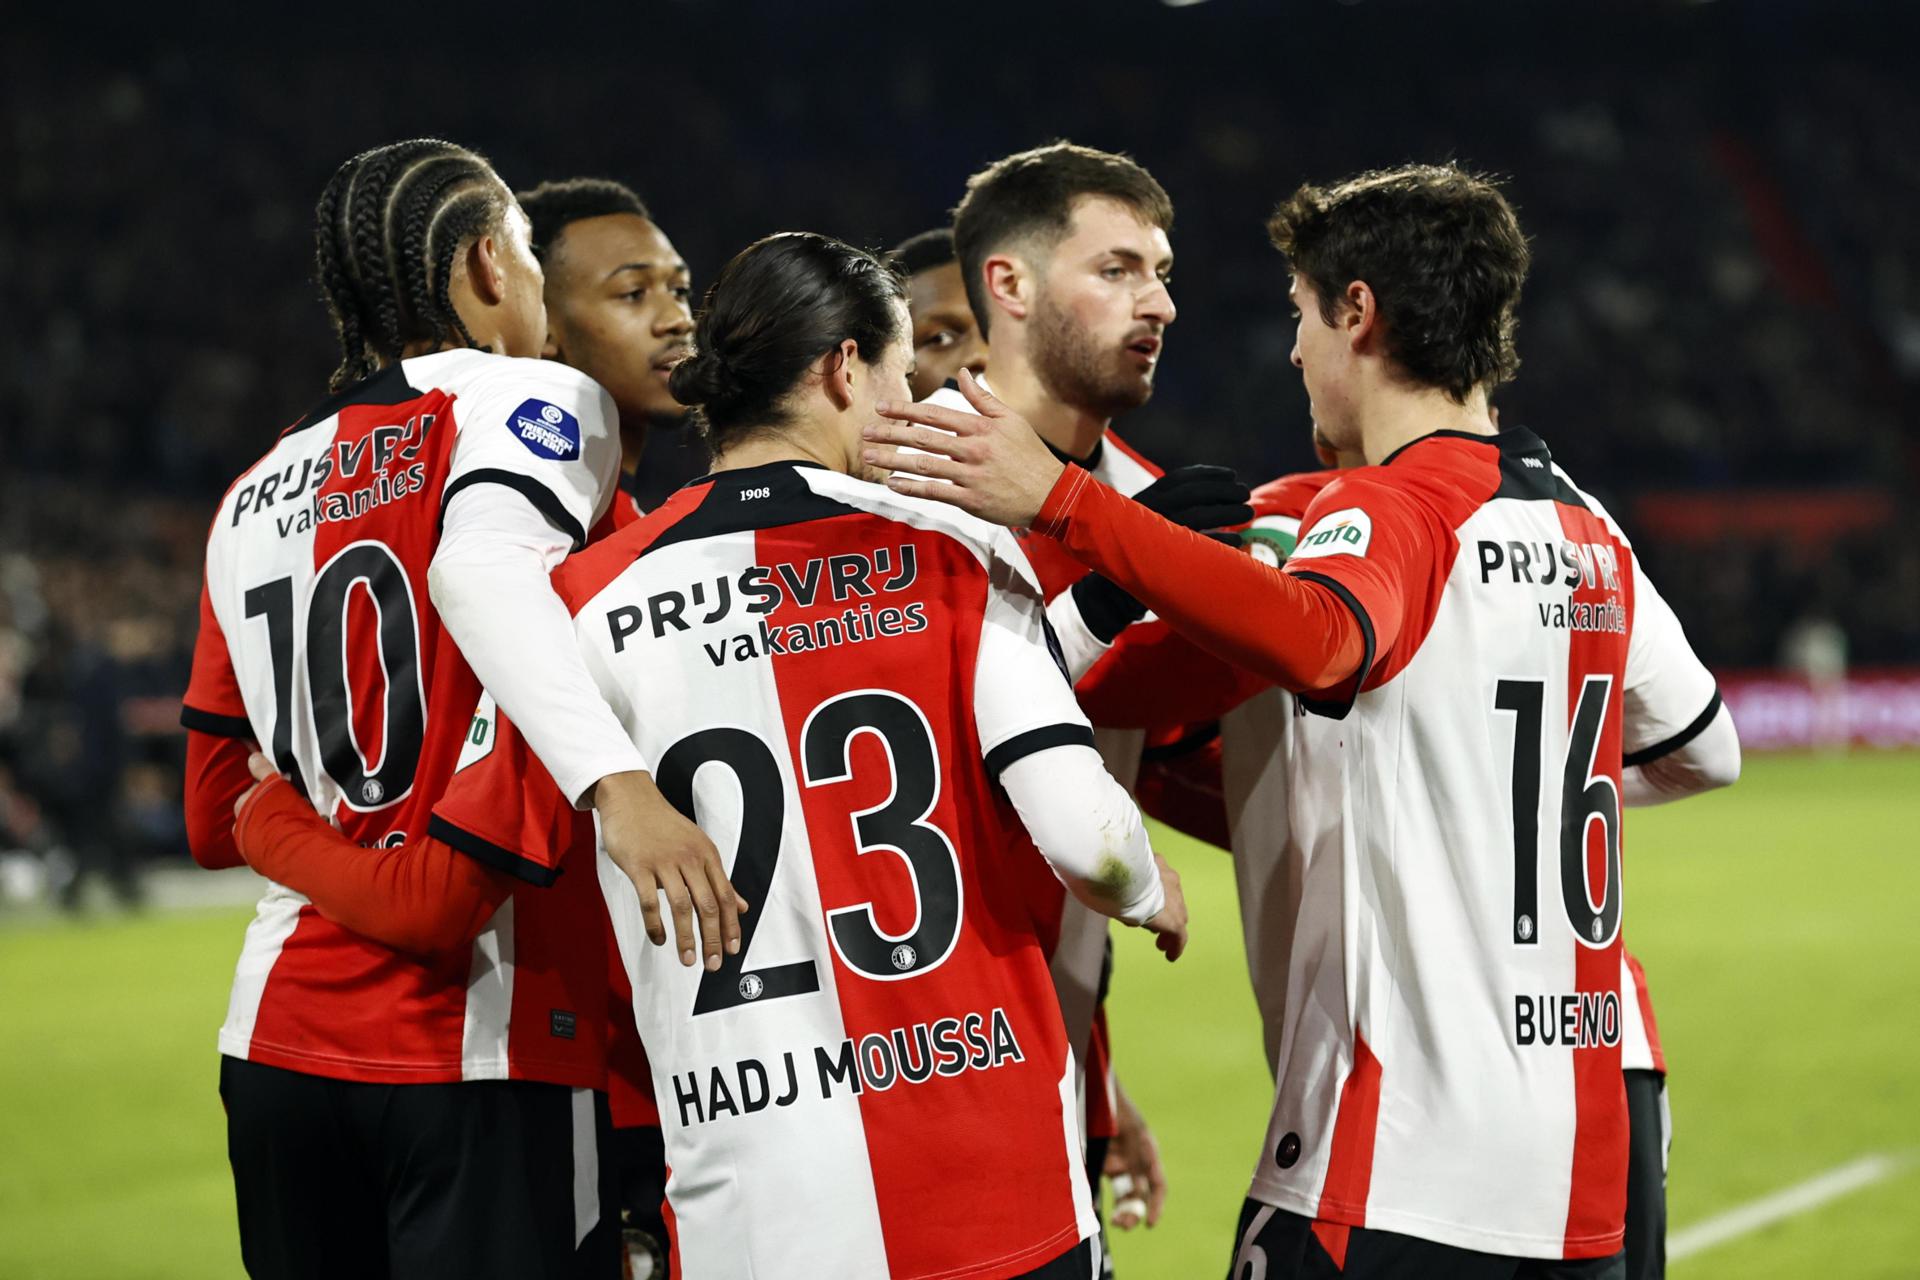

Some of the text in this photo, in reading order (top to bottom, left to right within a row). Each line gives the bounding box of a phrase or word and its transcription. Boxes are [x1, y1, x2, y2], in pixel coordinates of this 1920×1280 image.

[231, 414, 437, 528] PRIJSVRIJ
[517, 419, 574, 453] VRIENDEN
[521, 428, 564, 456] LOTERIJ
[276, 461, 426, 539] vakanties
[739, 486, 771, 502] 1908
[1302, 525, 1362, 550] TOTO
[606, 543, 918, 655] PRIJSVRIJ
[703, 601, 929, 668] vakanties
[244, 539, 428, 814] 10
[1492, 674, 1623, 950] 16
[655, 688, 964, 1017] 23
[1515, 993, 1622, 1048] BUENO
[672, 1007, 1025, 1127] HADJ MOUSSA
